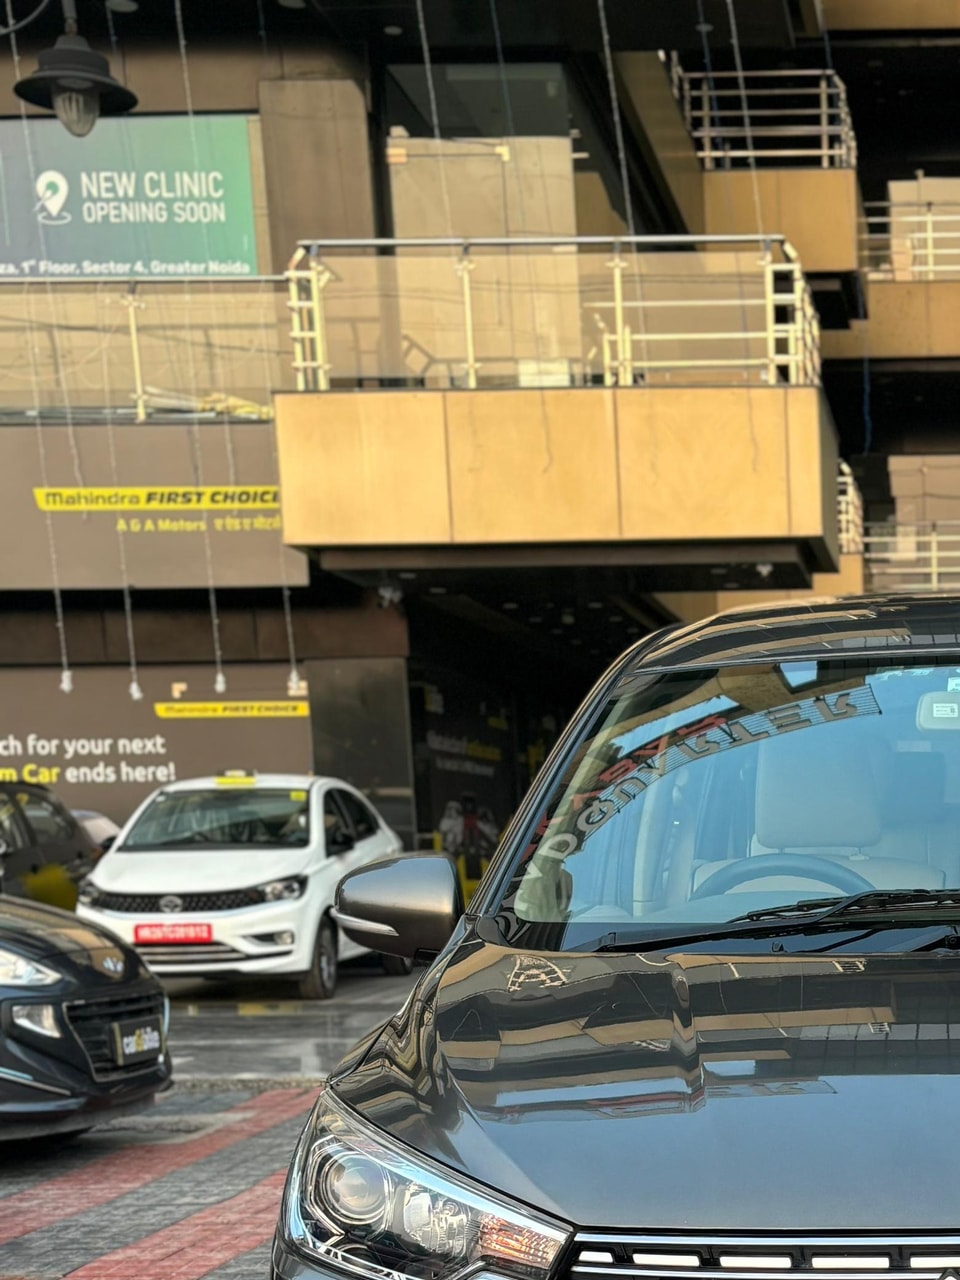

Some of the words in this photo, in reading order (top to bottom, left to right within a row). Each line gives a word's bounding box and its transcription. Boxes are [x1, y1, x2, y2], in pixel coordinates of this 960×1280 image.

[80, 171, 136, 198] NEW
[143, 171, 224, 198] CLINIC
[82, 201, 167, 224] OPENING
[174, 201, 226, 223] SOON
[82, 260, 131, 274] Sector
[150, 260, 206, 274] Greater
[208, 260, 250, 274] Noida
[44, 491, 140, 507] Mahindra
[145, 490, 206, 505] FIRST
[116, 518, 128, 532] A
[144, 518, 156, 532] A
[158, 517, 207, 532] Motors
[26, 733, 60, 755] for
[63, 738, 113, 760] your
[118, 734, 167, 754] next
[22, 763, 61, 784] Car
[65, 761, 117, 783] ends
[120, 761, 177, 782] here!
